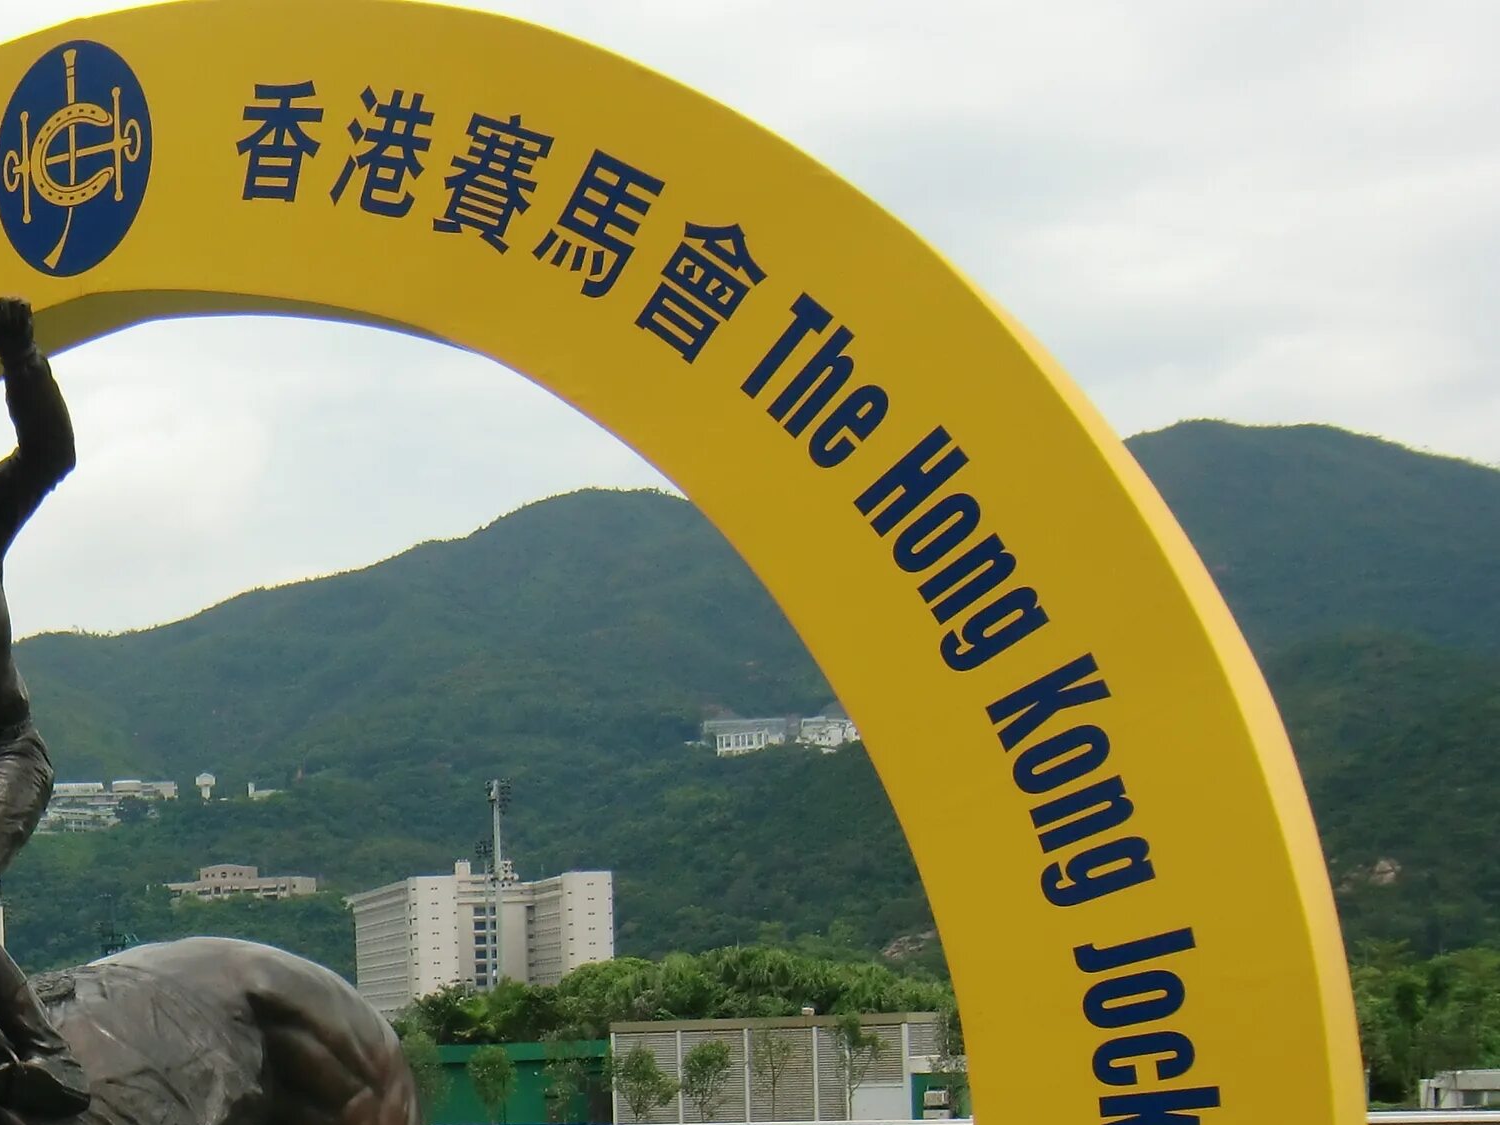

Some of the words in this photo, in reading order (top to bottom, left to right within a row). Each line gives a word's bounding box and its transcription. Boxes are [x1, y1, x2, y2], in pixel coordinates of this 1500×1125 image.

[235, 79, 768, 363] 香港賽馬會
[739, 291, 890, 469] The
[853, 424, 1050, 672] Hong
[985, 652, 1156, 907] Kong
